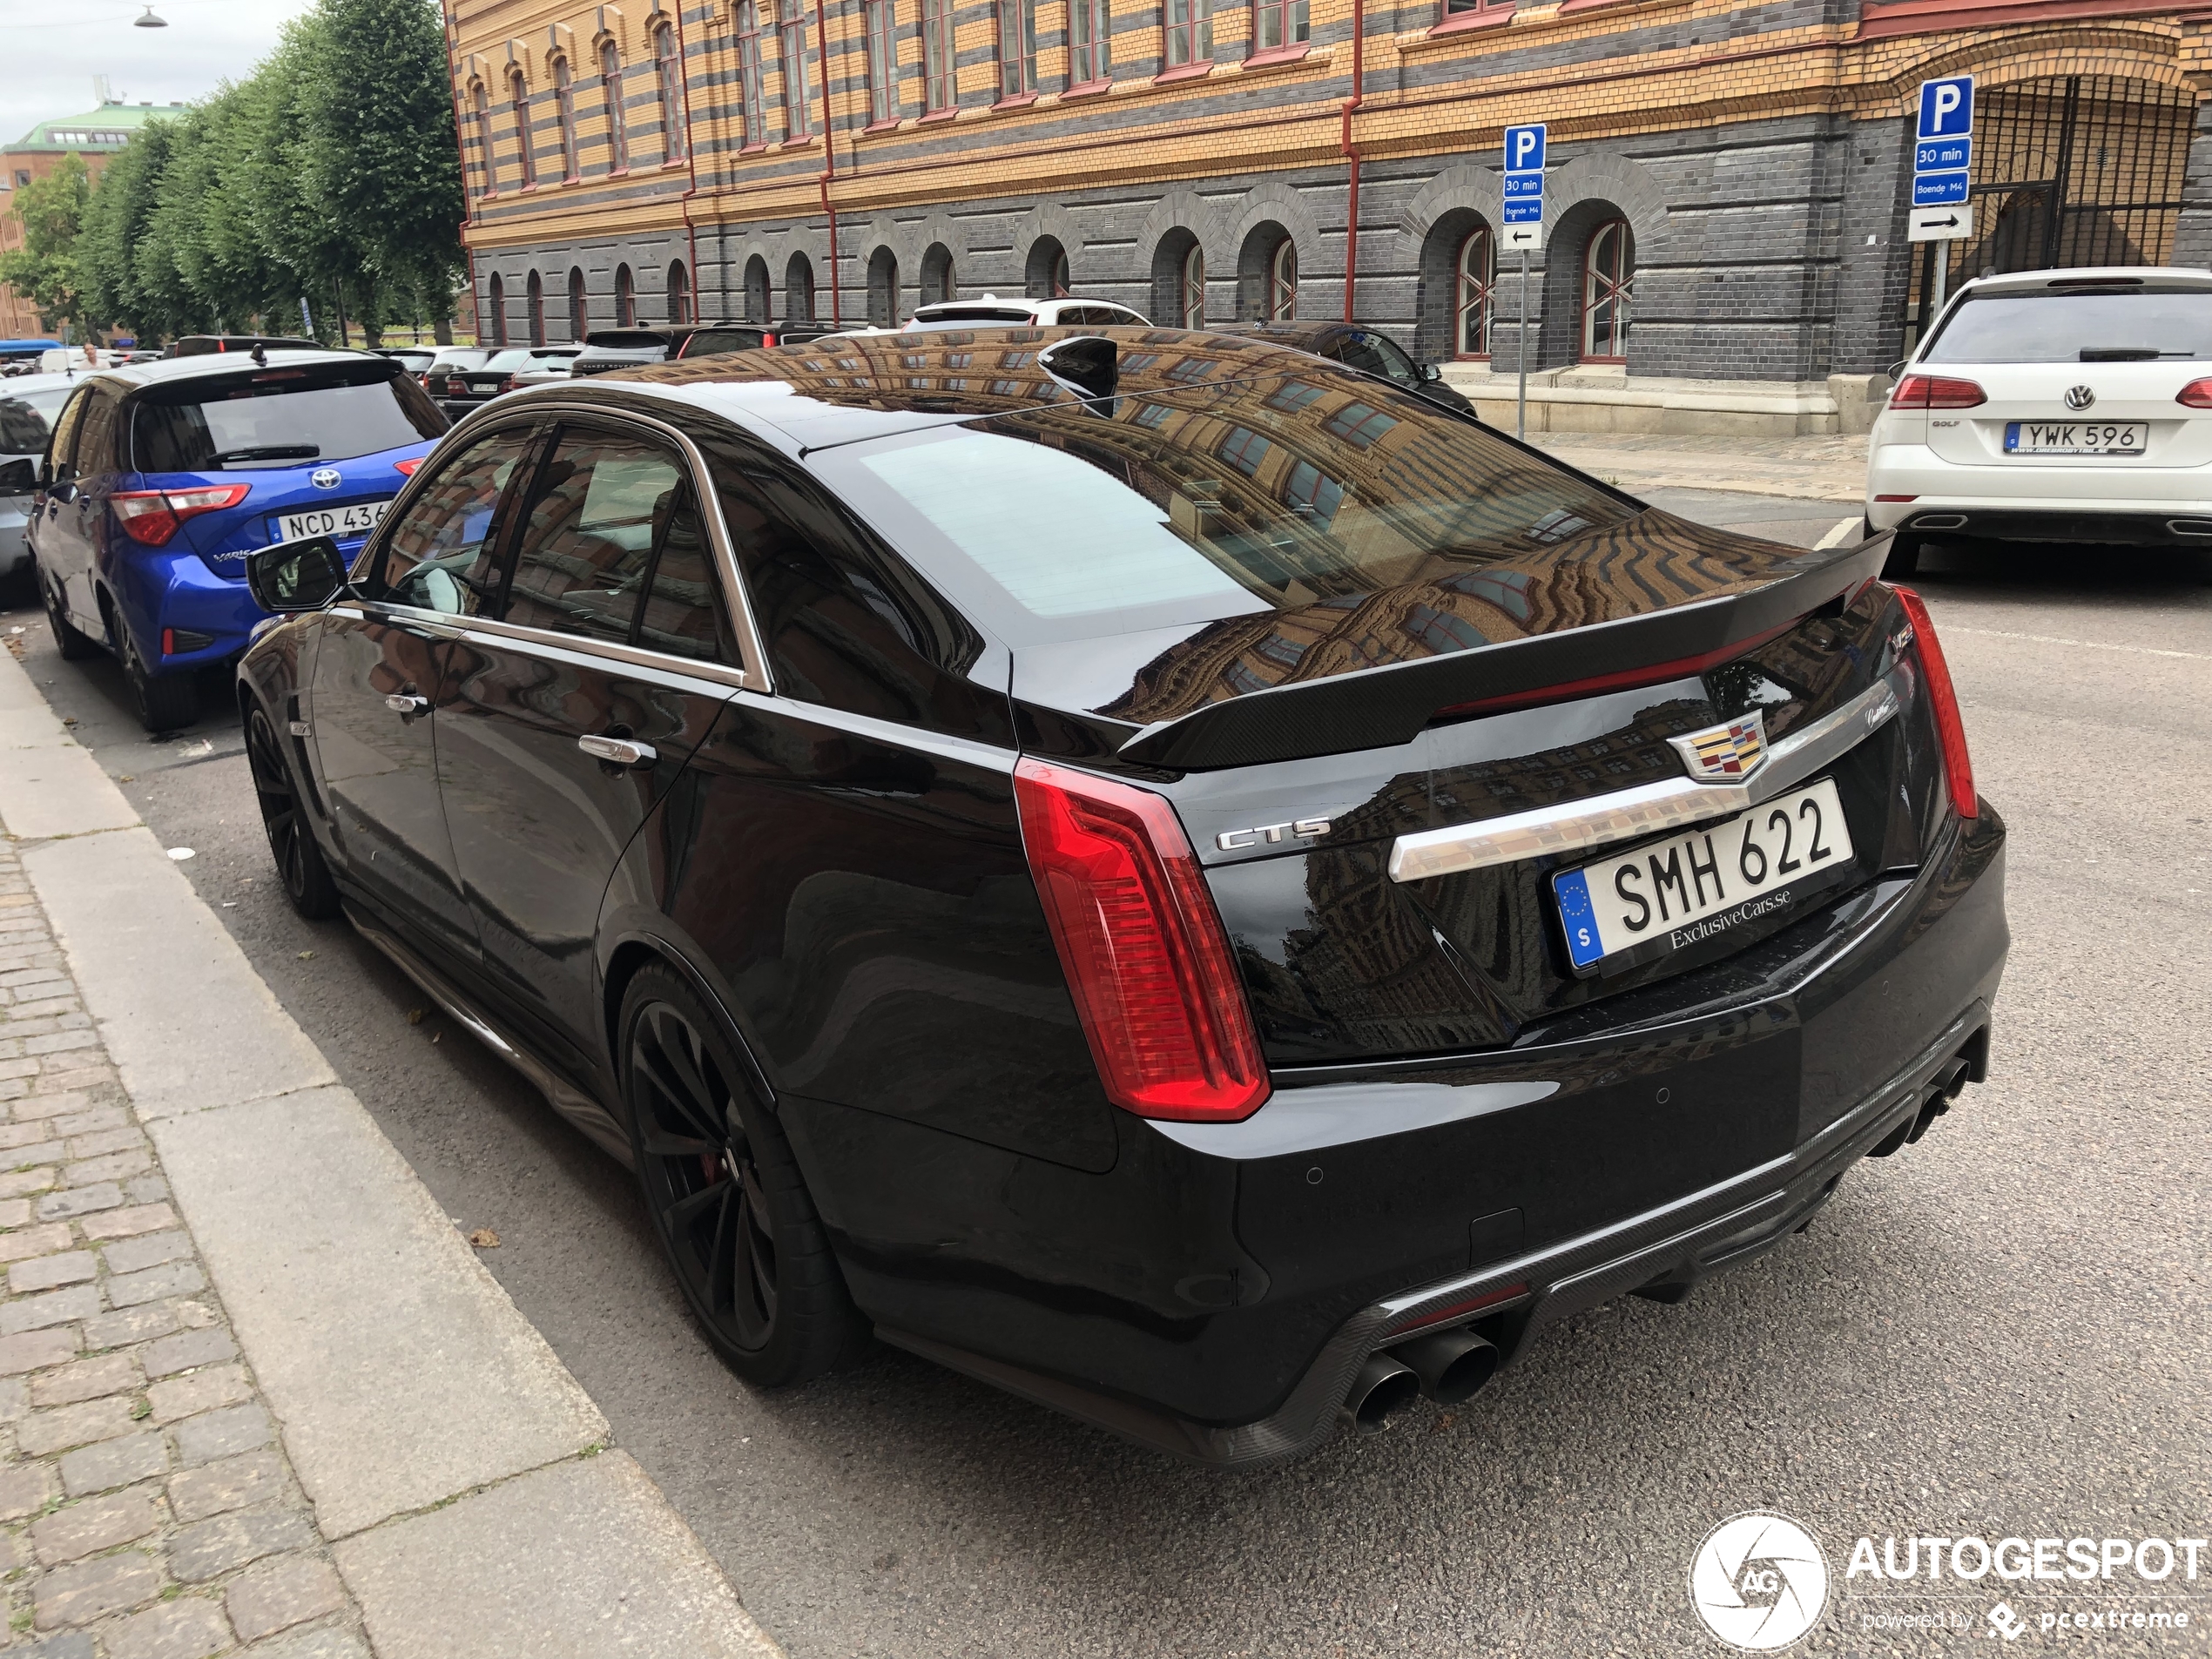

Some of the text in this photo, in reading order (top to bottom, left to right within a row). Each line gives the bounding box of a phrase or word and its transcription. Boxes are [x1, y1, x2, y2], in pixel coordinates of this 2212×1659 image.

[1934, 84, 1961, 132] P
[1516, 131, 1536, 168] P
[1919, 147, 1963, 164] 30 min
[1506, 179, 1538, 192] 30 min
[1917, 182, 1963, 194] Boende M4
[1506, 207, 1527, 216] Boende
[2029, 426, 2135, 447] YWK 596
[288, 505, 386, 538] NCD 436
[1217, 816, 1332, 851] CTS
[1614, 797, 1832, 932] SMH 622
[1669, 889, 1792, 950] ExclusiveCars.se
[1577, 927, 1591, 948] S
